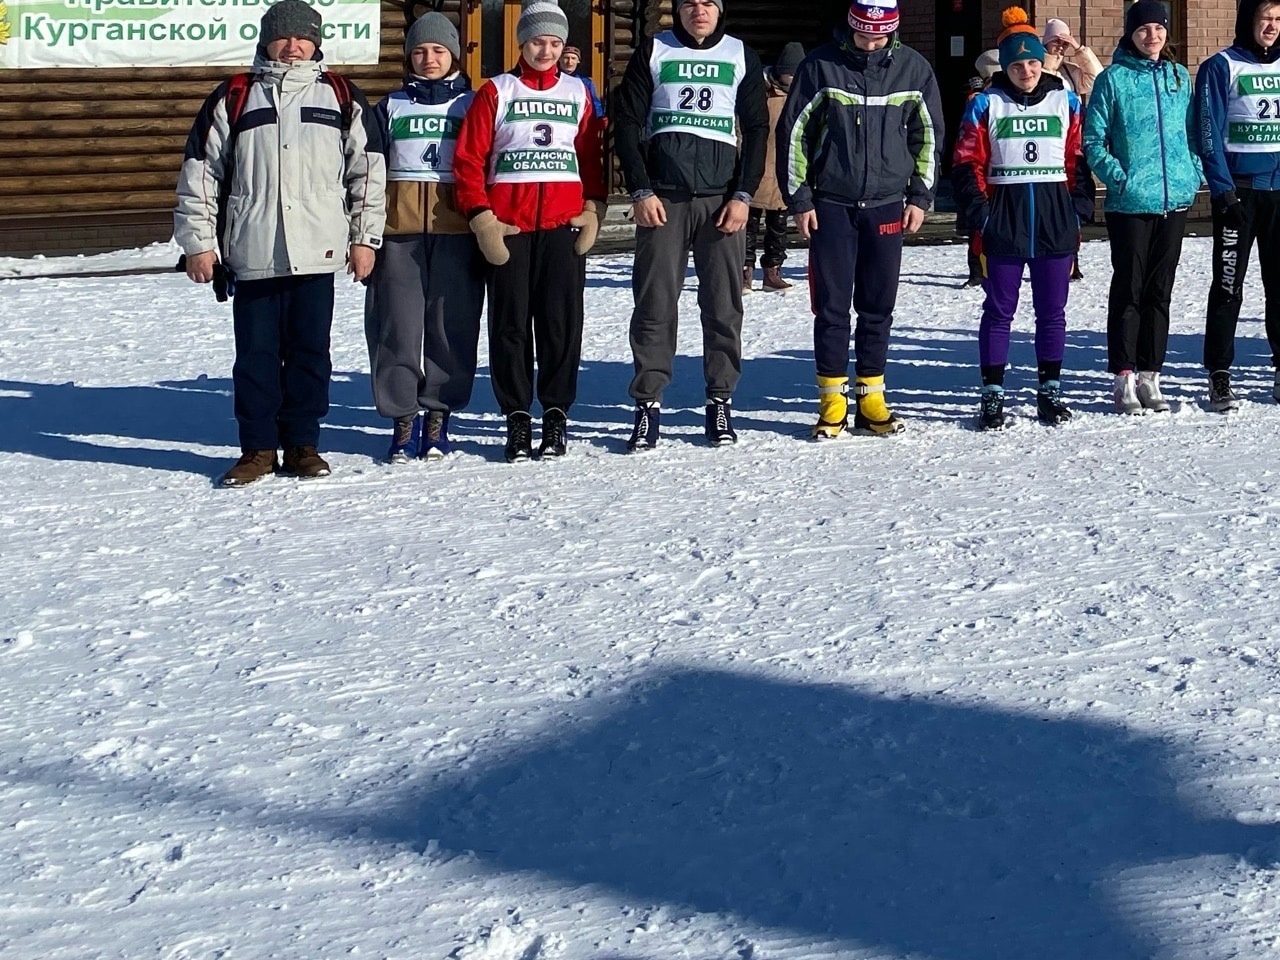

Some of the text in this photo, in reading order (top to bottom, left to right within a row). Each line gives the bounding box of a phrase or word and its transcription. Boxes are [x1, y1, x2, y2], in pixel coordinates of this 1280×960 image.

[25, 16, 371, 47] Курганской ости
[678, 63, 720, 79] ЦСП
[514, 101, 573, 117] ЦПСМ
[679, 87, 712, 111] 28
[409, 117, 453, 135] ЦСП
[658, 115, 729, 128] КУРГАНСКАЯ
[1012, 118, 1048, 135] ЦСП
[533, 124, 552, 147] 3
[422, 143, 440, 168] 4
[1024, 141, 1038, 163] 8
[512, 161, 568, 170] ОБЛАСТЬ
[1221, 250, 1238, 295] SPORT
